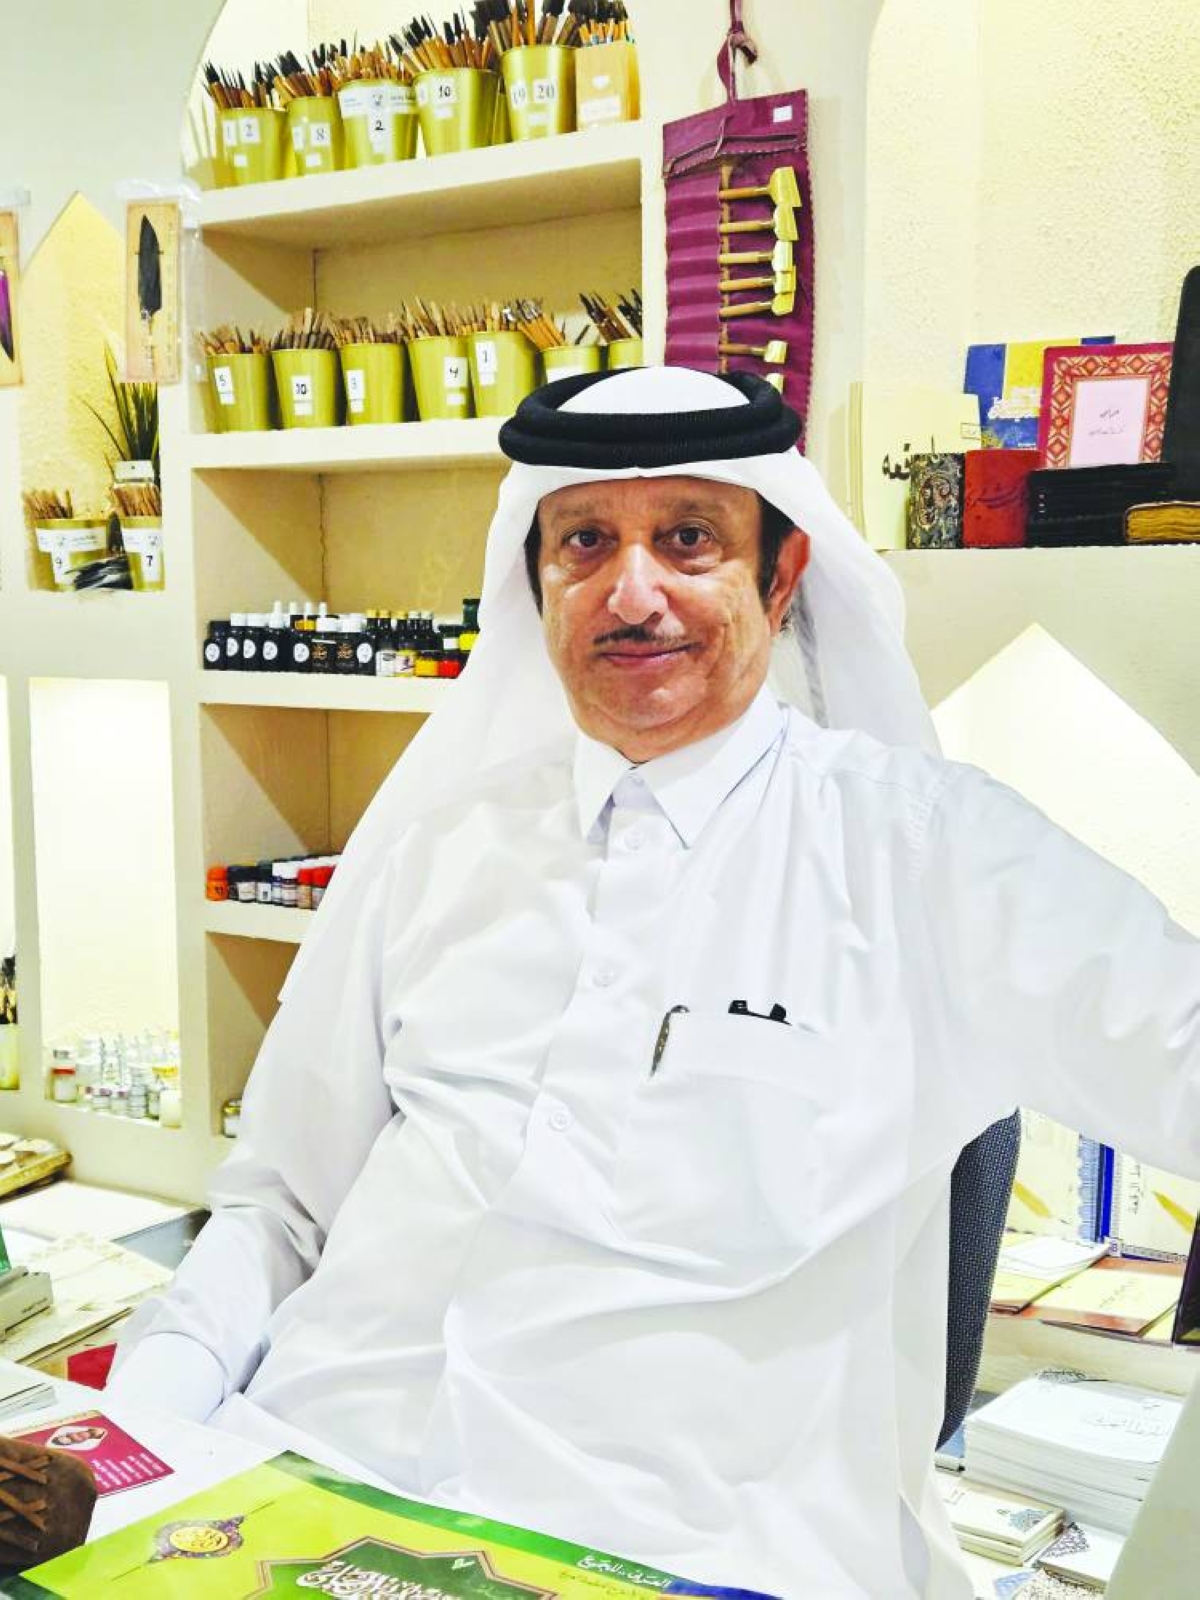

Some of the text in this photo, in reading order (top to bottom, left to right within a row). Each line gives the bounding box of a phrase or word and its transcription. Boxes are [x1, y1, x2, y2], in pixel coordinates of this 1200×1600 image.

[438, 85, 452, 98] 10
[535, 84, 555, 100] 20
[374, 119, 385, 131] 2
[449, 366, 459, 378] 4
[145, 555, 153, 567] 7
